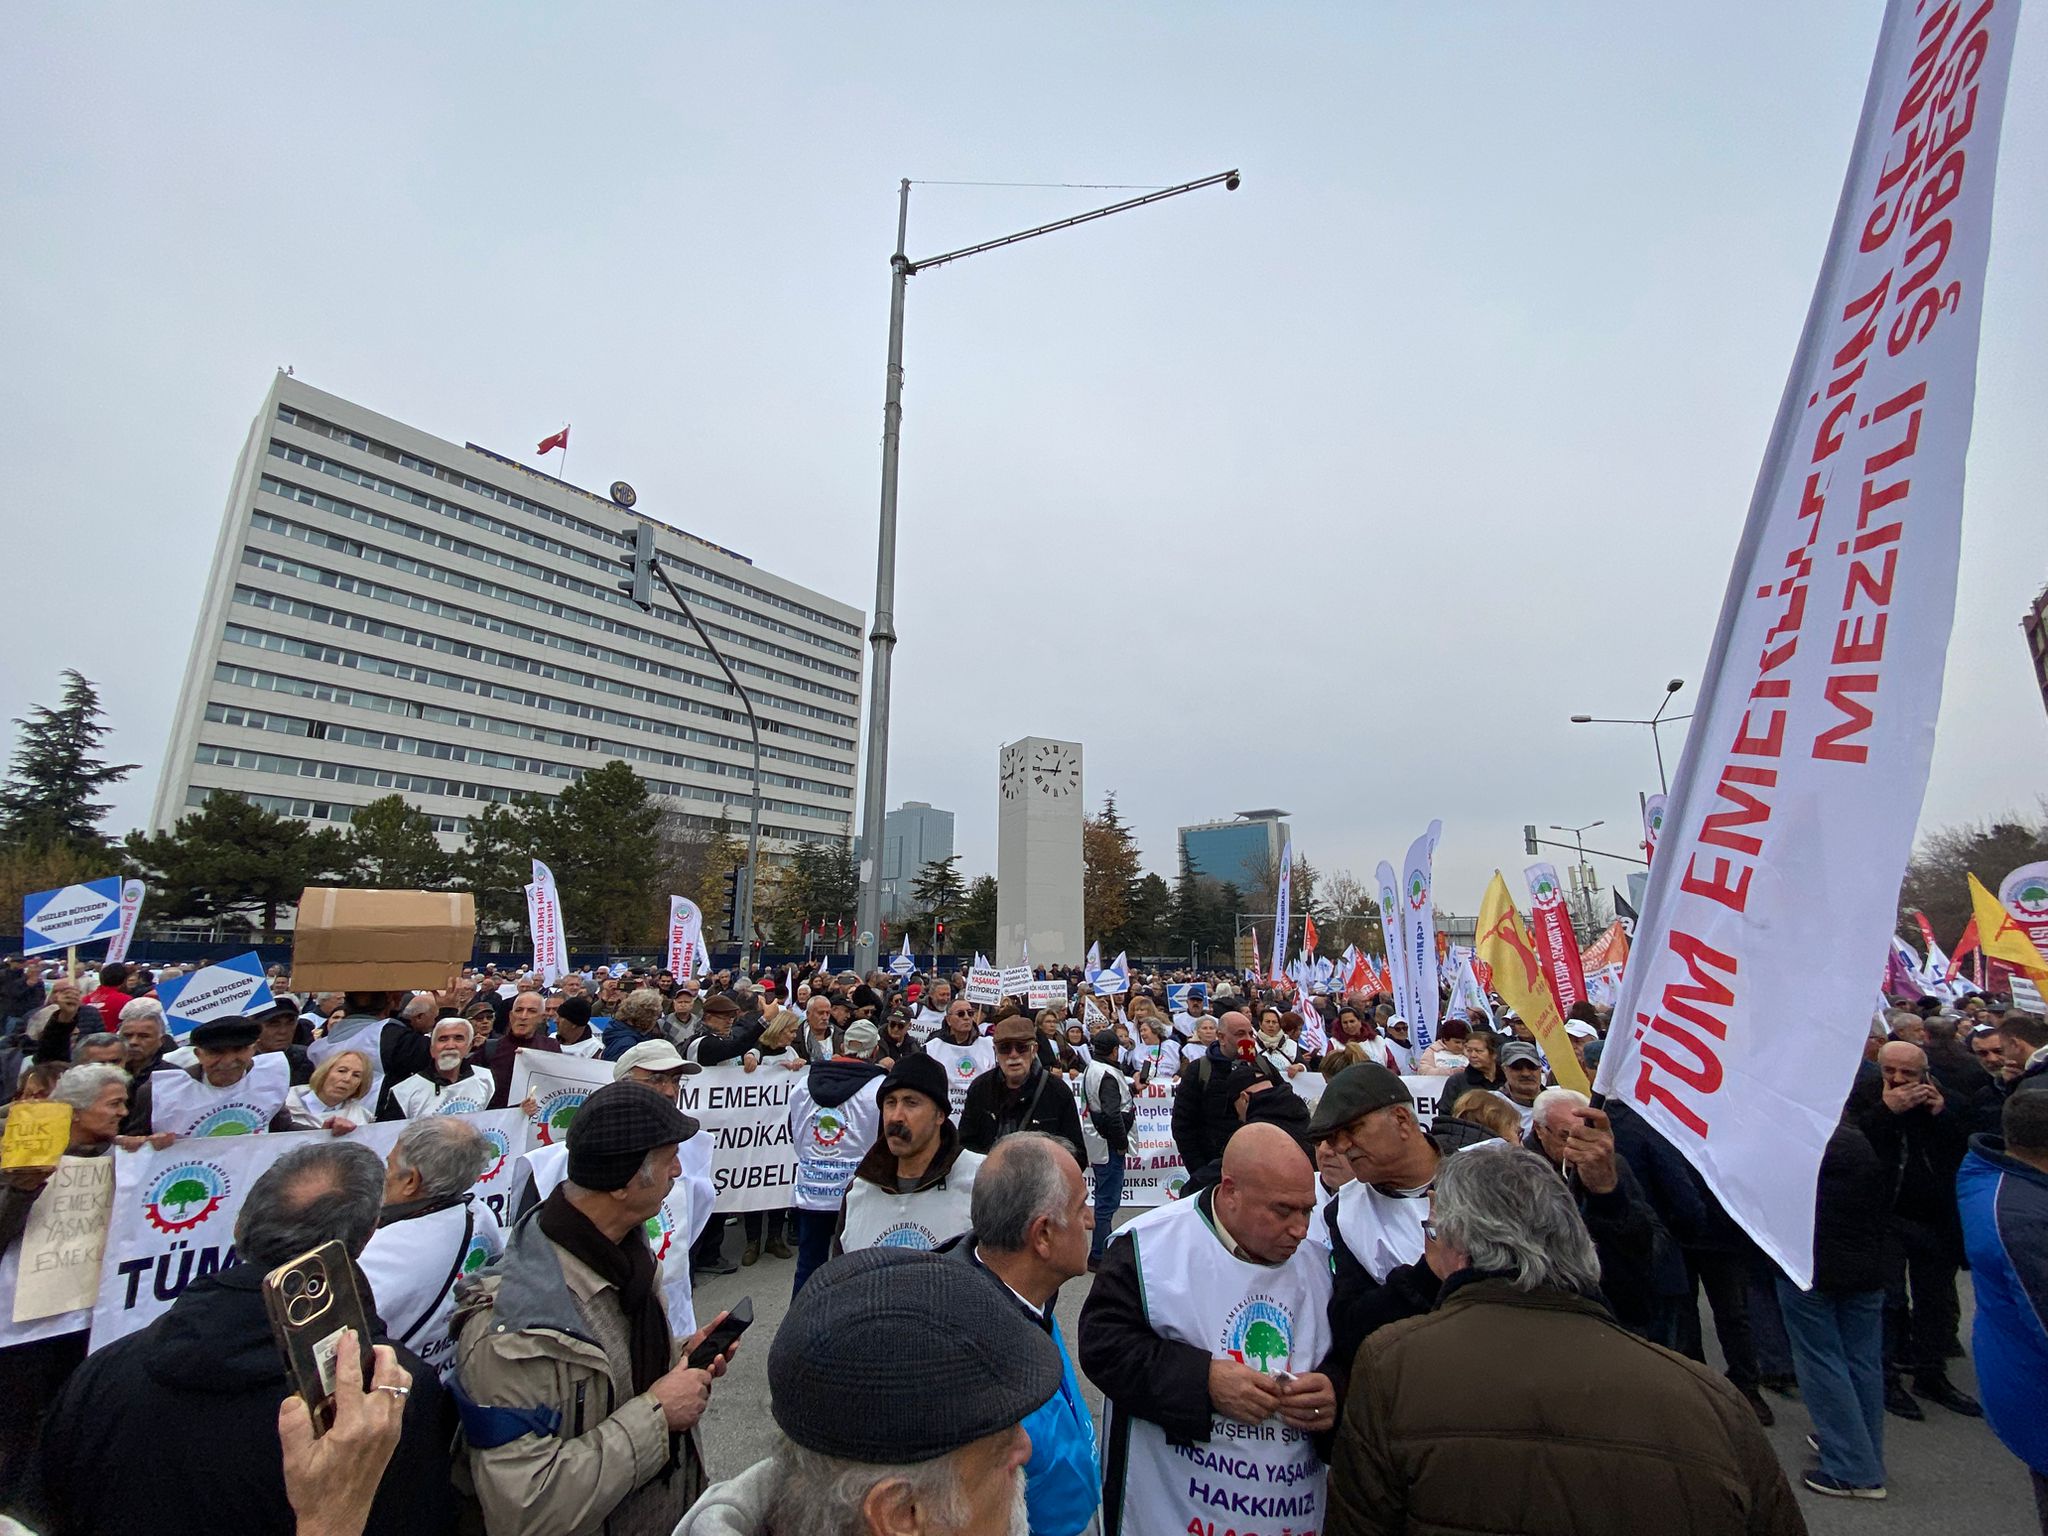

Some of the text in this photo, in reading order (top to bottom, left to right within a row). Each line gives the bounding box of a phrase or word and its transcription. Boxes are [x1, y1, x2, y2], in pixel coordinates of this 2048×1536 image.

[1811, 381, 1927, 763] MEZİTLİ
[972, 977, 1000, 986] YAŞAMAK
[973, 968, 1001, 978] İNSANCA
[176, 977, 254, 1008] GENÇLER BÜTÇEDEN
[185, 989, 251, 1017] HAKKINI İSTİYOR!
[1635, 929, 1737, 1139] TÜM
[708, 1080, 795, 1109] EMEKLİ
[872, 1221, 919, 1247] MEKLİLERİN
[1226, 1294, 1275, 1325] EMEKLİLERİN
[1188, 1477, 1316, 1518] HAKKIMIZ
